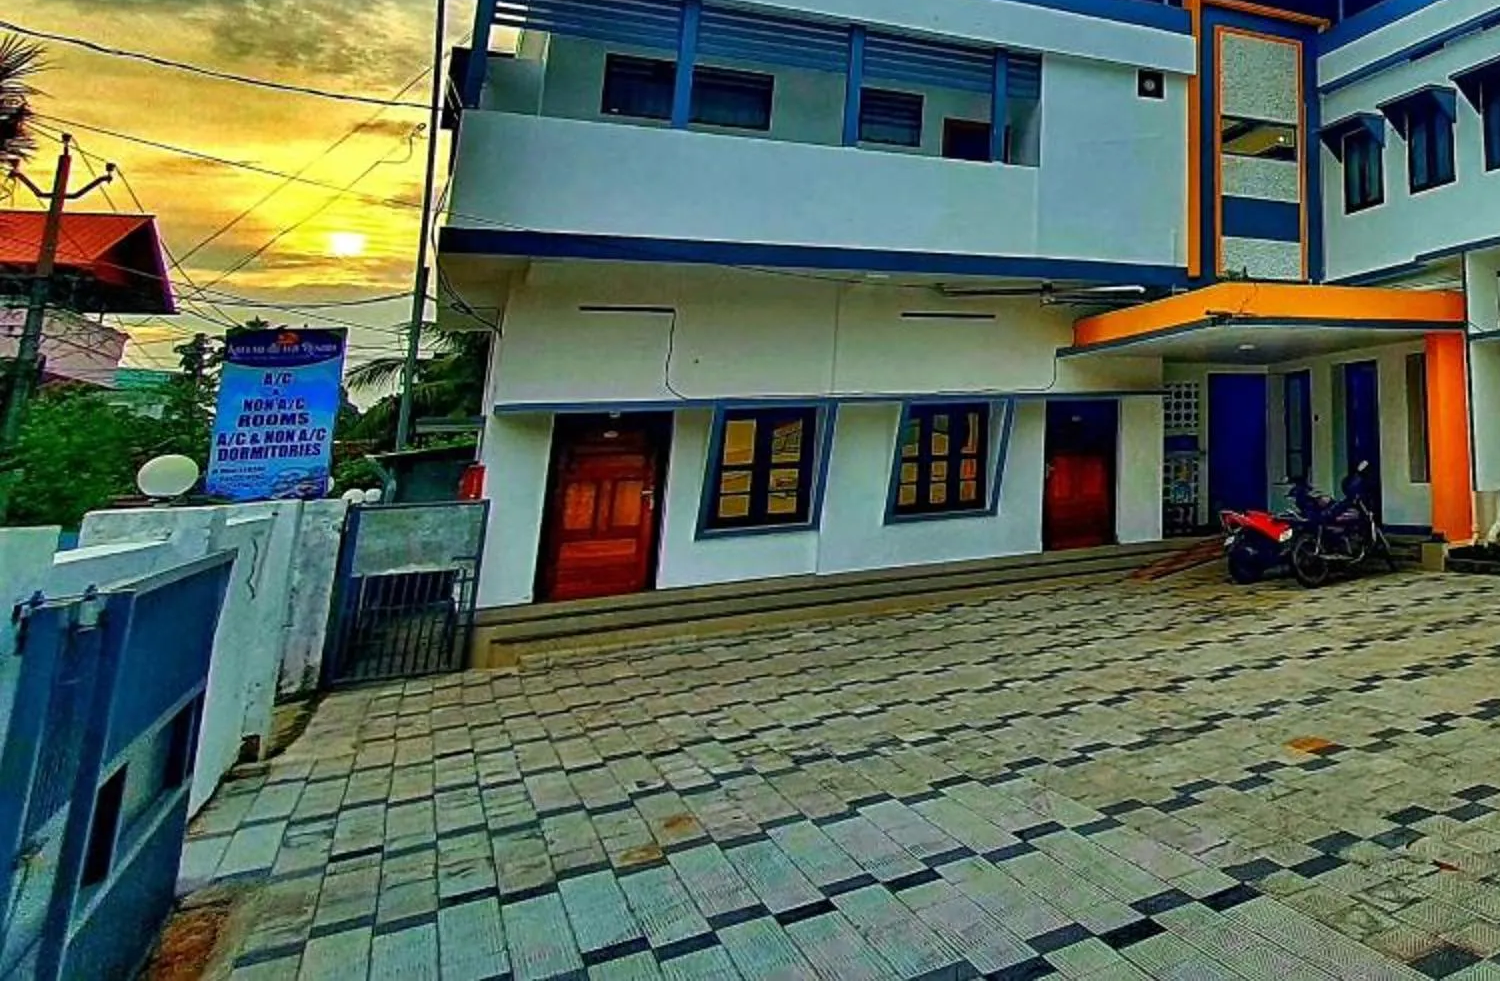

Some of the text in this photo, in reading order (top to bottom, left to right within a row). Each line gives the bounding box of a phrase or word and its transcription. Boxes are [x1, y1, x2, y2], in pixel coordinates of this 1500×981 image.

[264, 373, 292, 386] A/C
[244, 398, 305, 412] NON A/C
[238, 413, 310, 427] ROOMS
[217, 429, 327, 446] A/C & NON A/C
[218, 444, 321, 461] DORMITORIES
